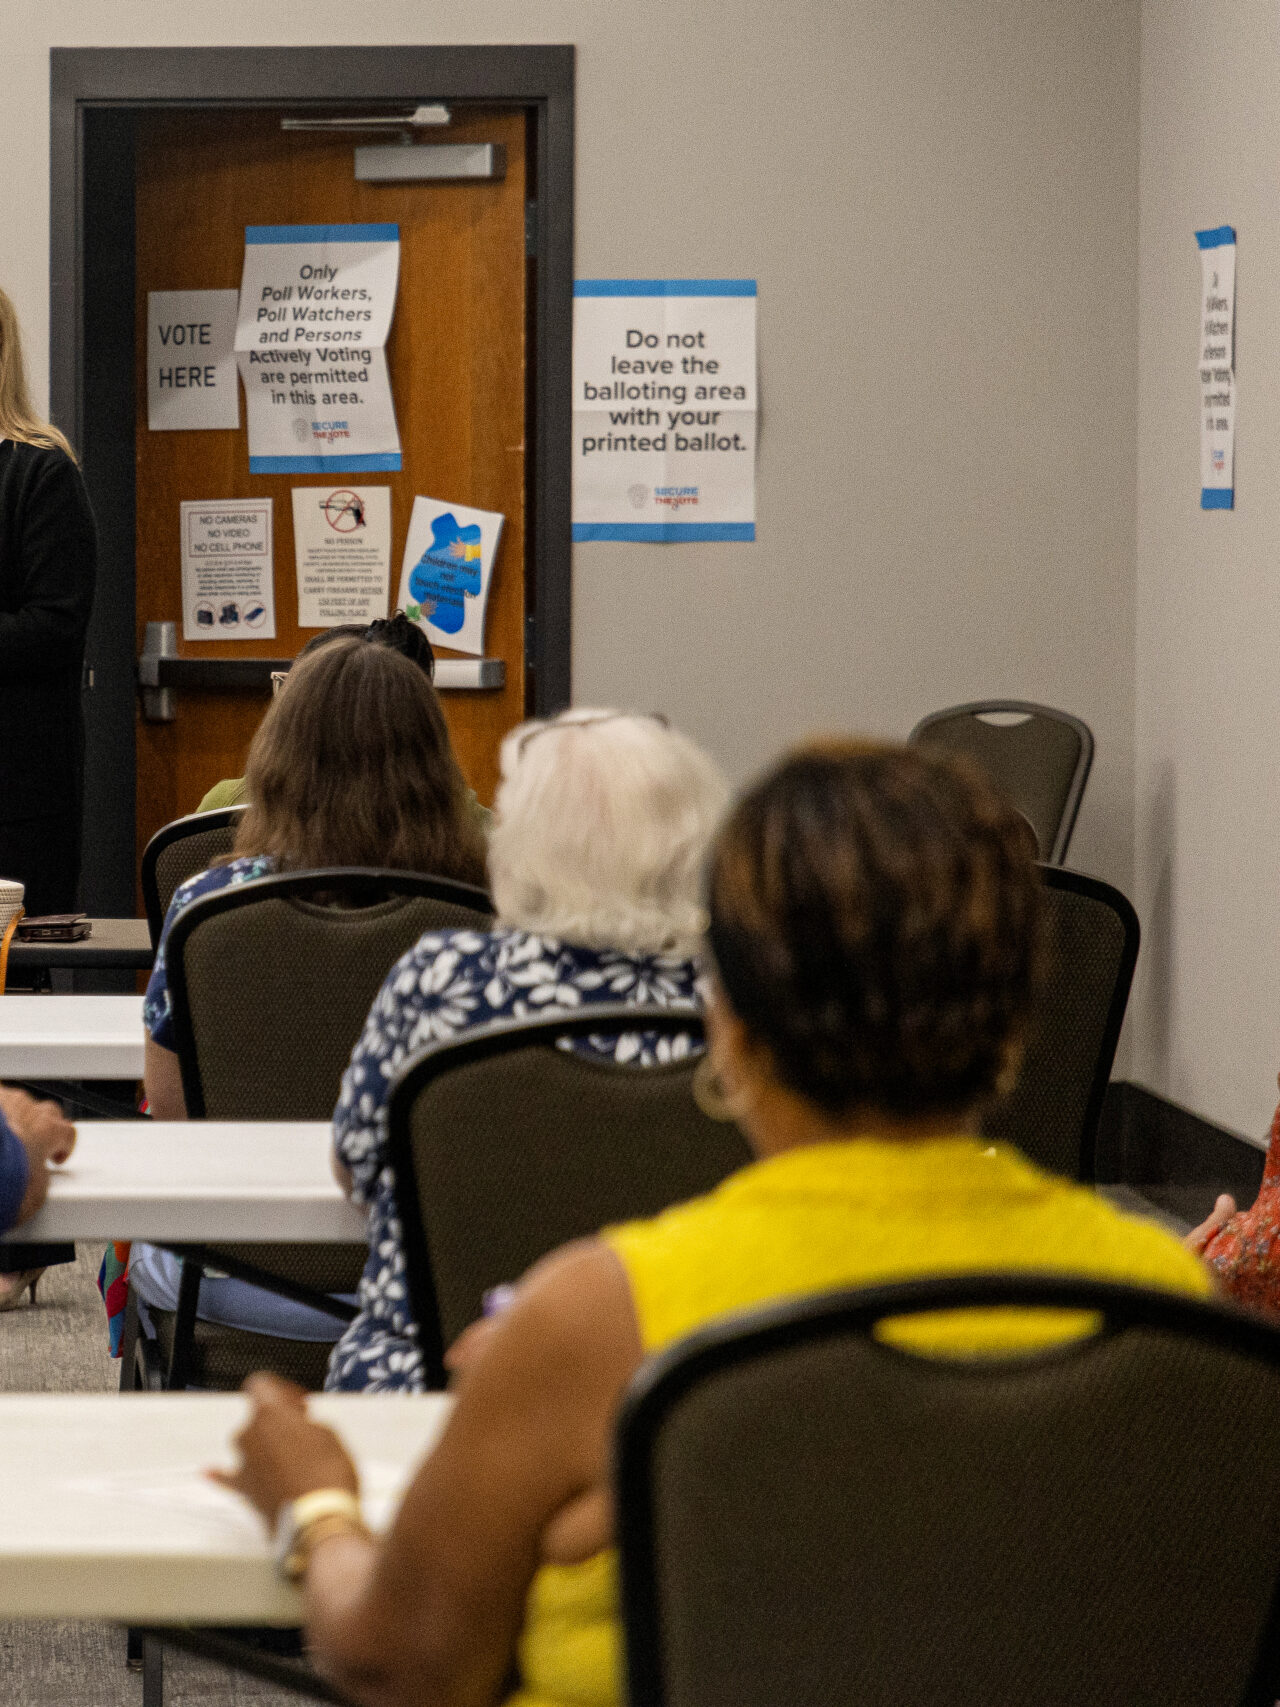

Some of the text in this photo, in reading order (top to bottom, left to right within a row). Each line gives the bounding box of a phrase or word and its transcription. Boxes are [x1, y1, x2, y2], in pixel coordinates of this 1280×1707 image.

[299, 264, 338, 281] Only
[261, 286, 373, 302] Poll Workers,
[256, 306, 372, 323] Poll Watchers
[158, 323, 212, 346] VOTE
[259, 327, 363, 344] and Persons
[625, 330, 706, 349] Do not
[249, 347, 372, 367] Actively Voting
[610, 355, 720, 375] leave the
[158, 366, 217, 389] HERE
[260, 367, 369, 387] are permitted
[271, 389, 364, 406] in this area.
[583, 381, 747, 405] balloting area
[608, 408, 722, 430] with your
[581, 433, 748, 456] printed ballot.
[199, 515, 257, 525] NO CAMERAS
[208, 528, 250, 538] NO VIDEO
[194, 542, 264, 552] NO CELL PHONE
